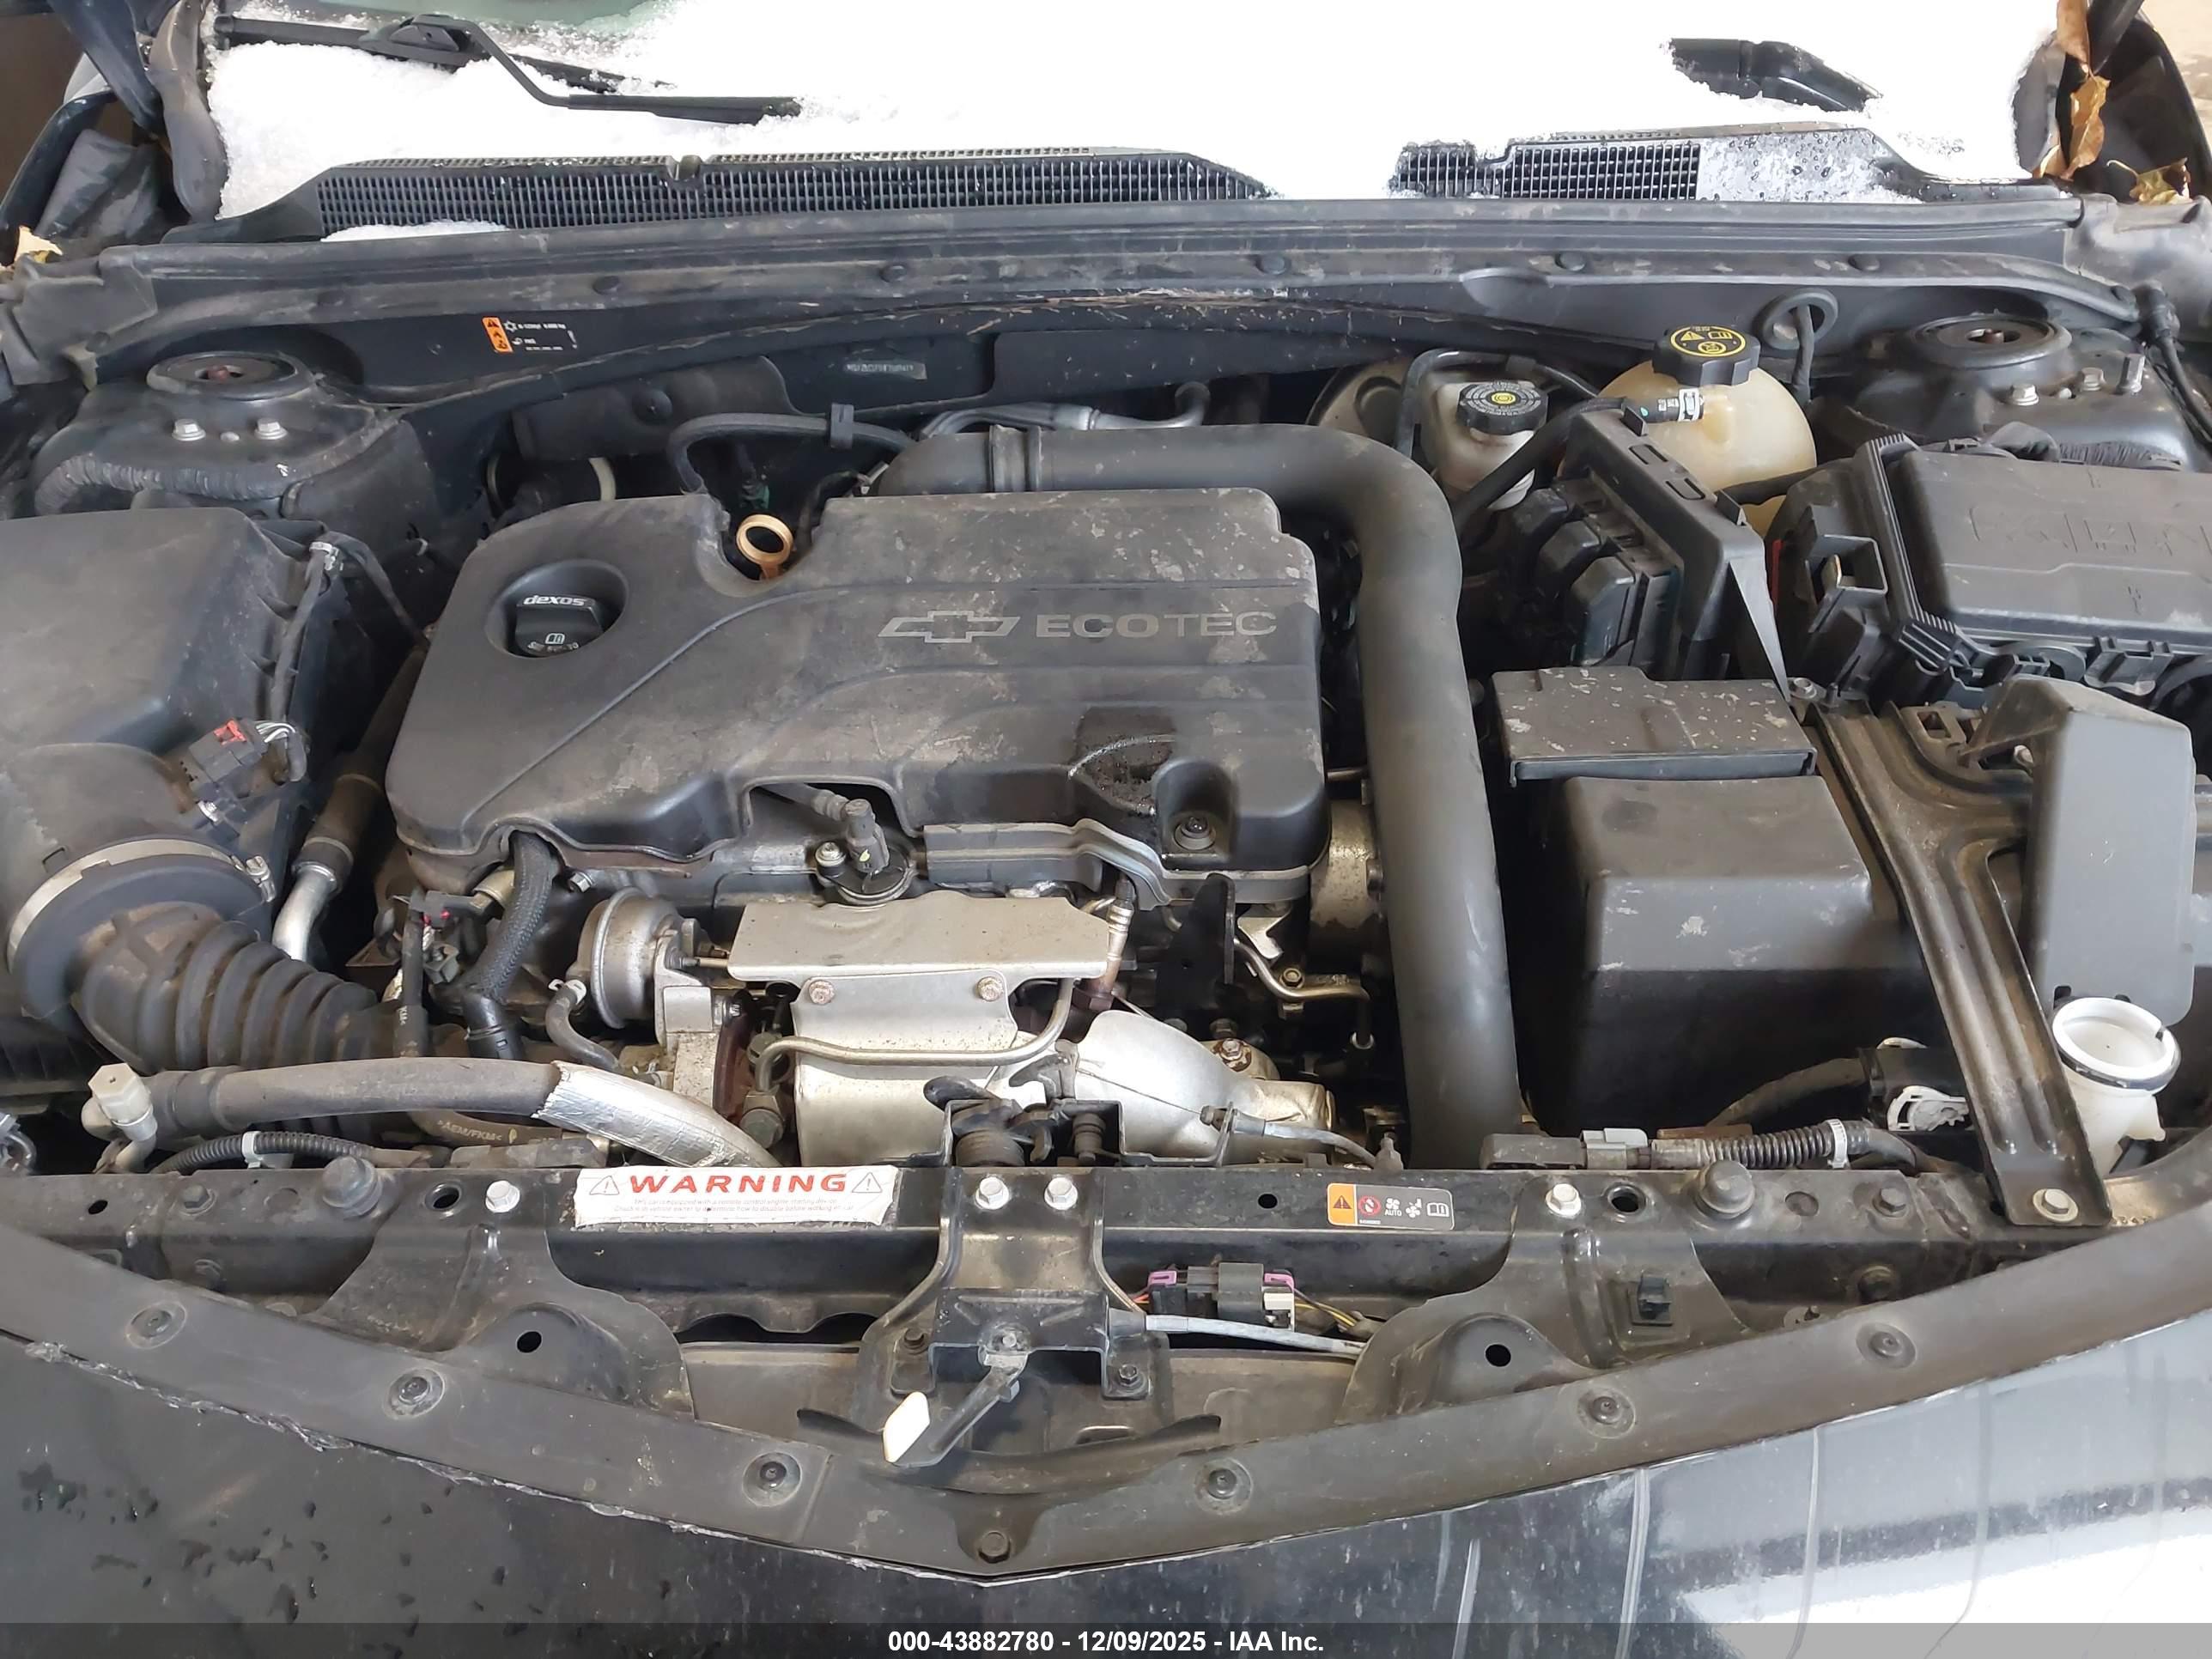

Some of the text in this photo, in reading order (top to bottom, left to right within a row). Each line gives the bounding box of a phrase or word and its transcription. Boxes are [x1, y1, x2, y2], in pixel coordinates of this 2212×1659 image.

[523, 595, 586, 606] dexos
[1036, 611, 1277, 638] ECOTEC
[630, 1174, 846, 1193] WARNING
